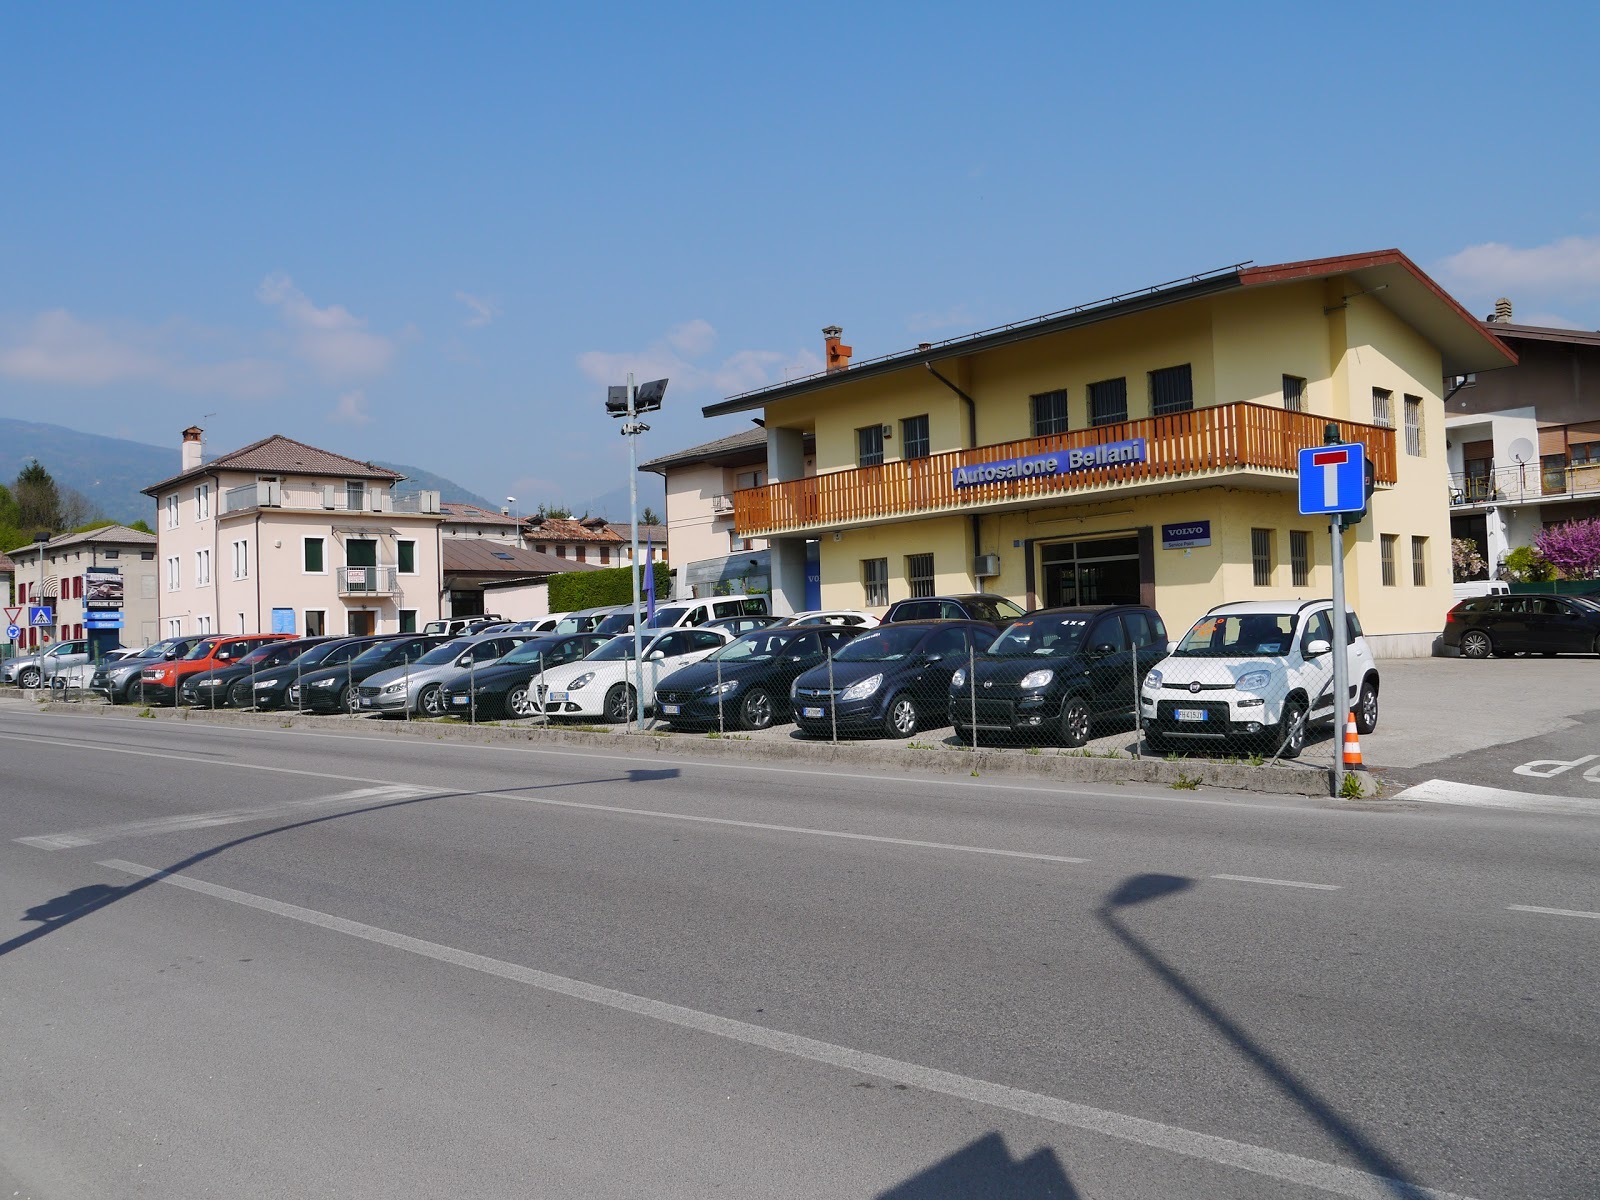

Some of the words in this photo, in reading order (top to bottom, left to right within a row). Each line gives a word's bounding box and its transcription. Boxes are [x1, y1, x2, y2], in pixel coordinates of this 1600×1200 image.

[955, 457, 1058, 486] Autosalone
[1068, 441, 1140, 469] Bellani
[1168, 527, 1203, 536] VOLVO
[808, 575, 820, 583] VO
